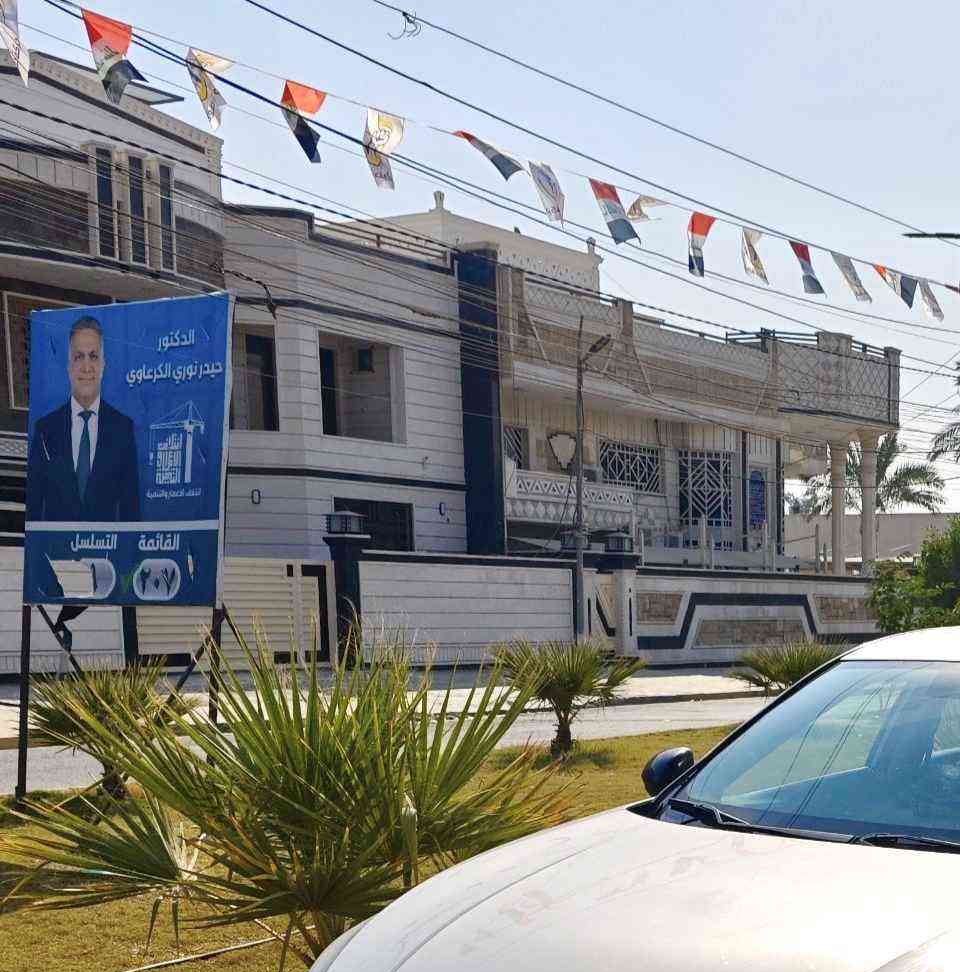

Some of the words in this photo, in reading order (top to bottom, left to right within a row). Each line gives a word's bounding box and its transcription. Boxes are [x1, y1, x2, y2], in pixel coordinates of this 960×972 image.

[158, 328, 195, 352] الدكتور
[127, 363, 171, 387] الكرعاوي
[173, 361, 198, 384] نوري
[198, 361, 223, 380] حيدر
[70, 533, 117, 552] التسلسل
[138, 533, 180, 551] القائمة
